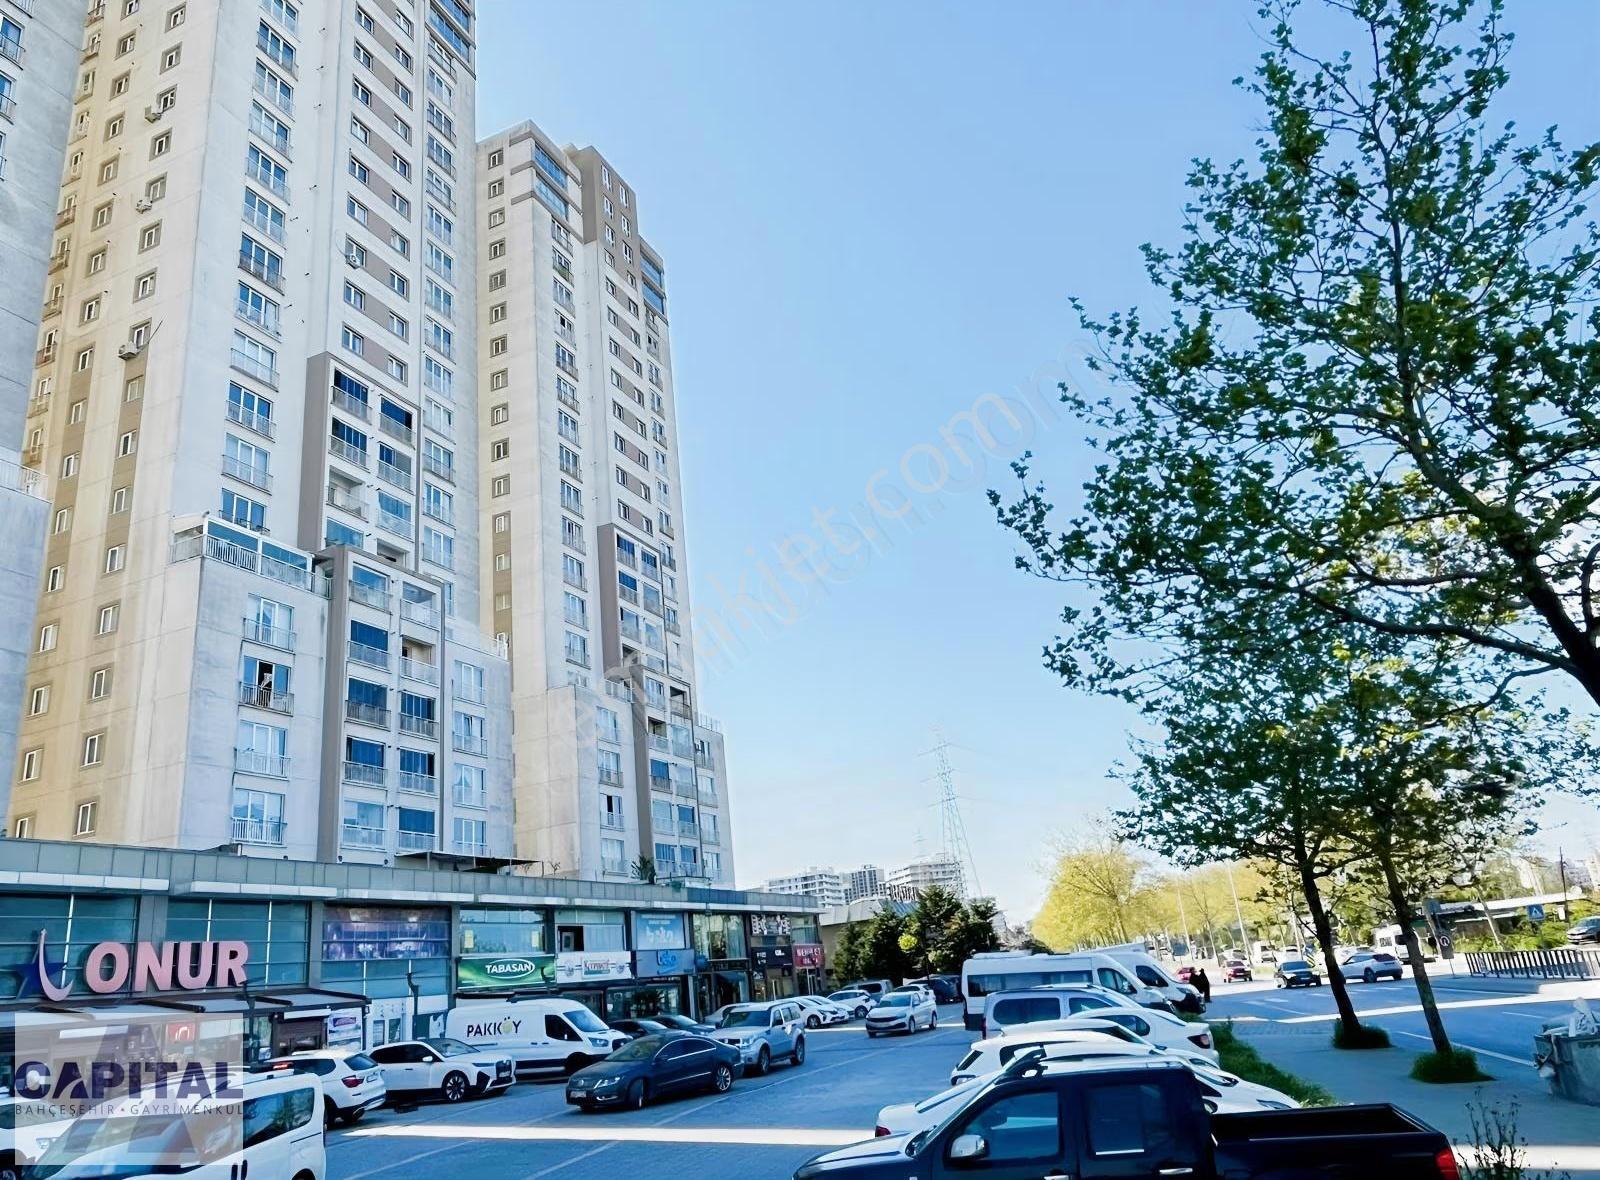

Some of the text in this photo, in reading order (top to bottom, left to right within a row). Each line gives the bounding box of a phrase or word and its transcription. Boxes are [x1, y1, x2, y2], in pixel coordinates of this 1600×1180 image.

[85, 940, 249, 994] ONUR
[485, 963, 532, 974] TABASAN
[466, 1015, 522, 1038] PAKKÖY
